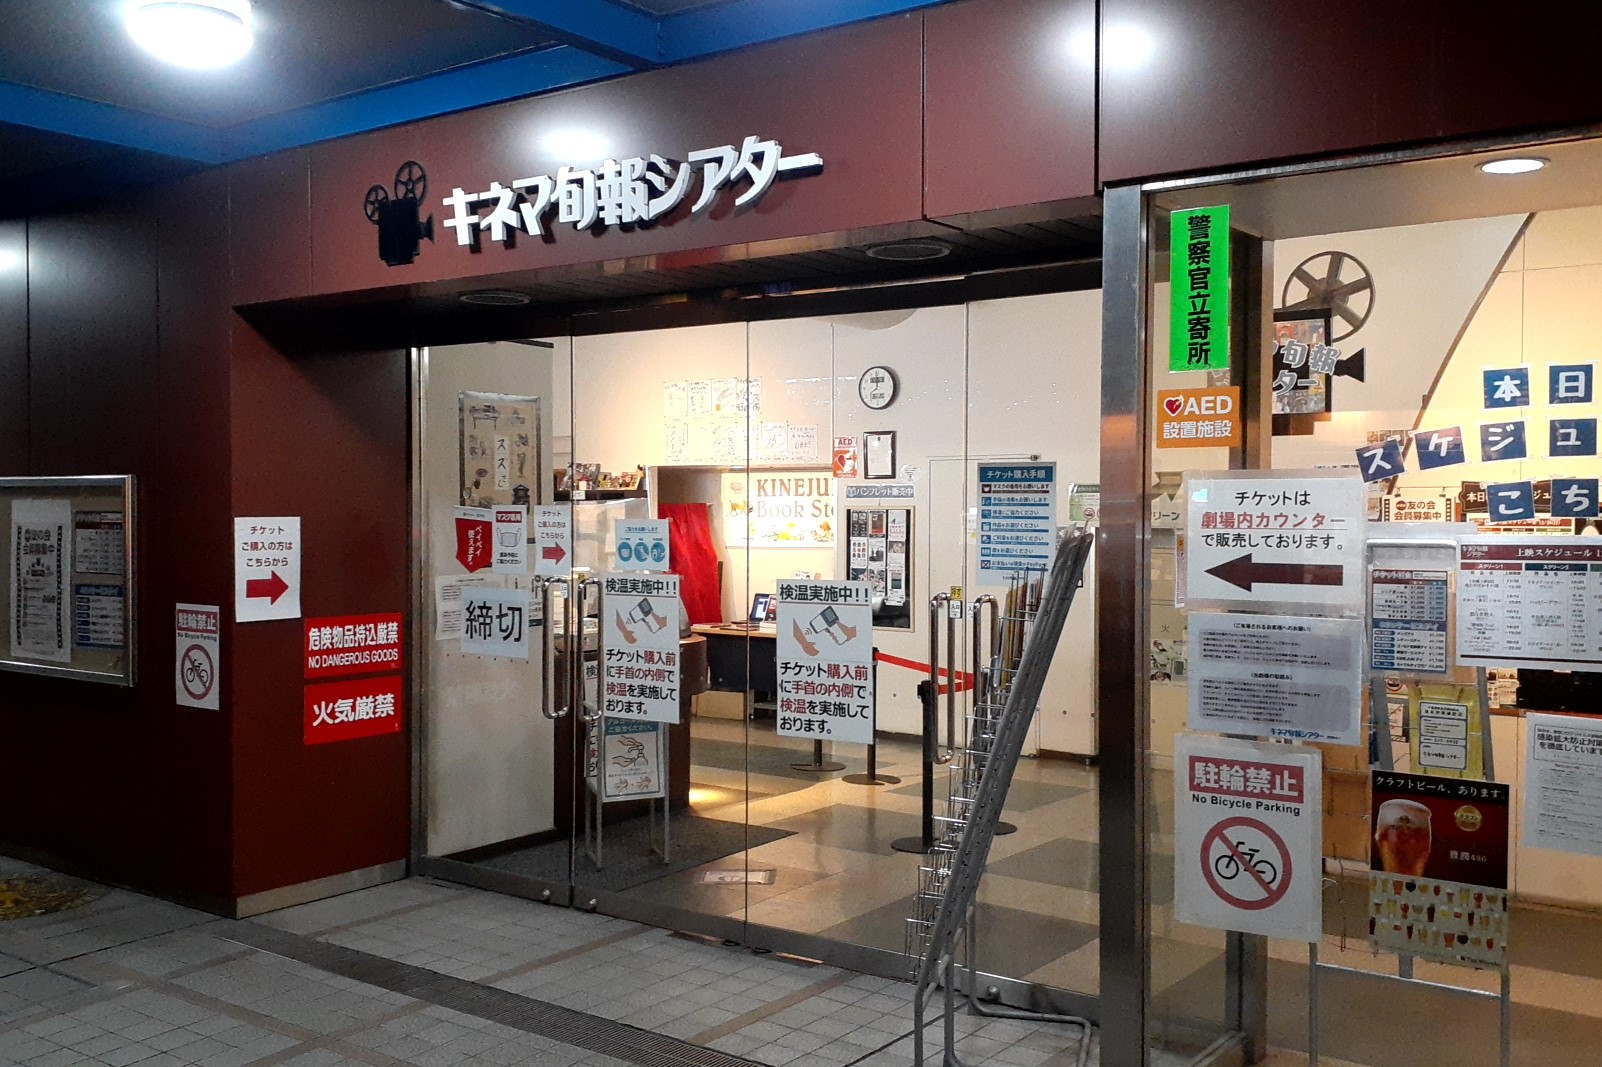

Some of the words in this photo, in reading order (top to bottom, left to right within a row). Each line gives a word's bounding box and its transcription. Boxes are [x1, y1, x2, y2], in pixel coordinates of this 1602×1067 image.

[443, 136, 824, 246] キネマ旬報シアター
[1187, 214, 1211, 366] 警察官立寄所
[1273, 339, 1340, 376] 旬報
[1493, 371, 1586, 402] 本日
[1184, 396, 1233, 415] AED
[1163, 420, 1233, 440] 設置施設
[837, 438, 853, 446] AED
[986, 470, 1046, 479] チケット購入手順
[756, 477, 834, 497] KINEJU
[1234, 490, 1311, 506] チケットは
[1201, 511, 1345, 529] 劇場内カウンター
[251, 526, 285, 535] チケット
[541, 532, 565, 540] こちらから
[242, 541, 293, 551] ご購入の方は
[1201, 532, 1343, 550] で販売しております。
[246, 557, 289, 567] こちらから
[605, 577, 677, 595] 検温実施中!!
[779, 584, 869, 603] 検温実施中!!
[465, 600, 523, 643] 締切
[308, 621, 399, 651] 危険物品持込厳禁
[308, 655, 321, 669] NO
[321, 650, 371, 668] DANGEROUS
[370, 648, 399, 662] GOODS
[605, 648, 677, 667] チケット購入前
[606, 665, 675, 683] に手首の内側で
[780, 661, 868, 681] チケット購入前
[605, 681, 677, 701] 検温を実施して
[780, 680, 867, 699] に手首の内側で
[312, 693, 395, 727] 火気厳禁
[605, 699, 648, 715] おります。
[780, 697, 869, 719] 検温を実施して
[780, 716, 832, 735] おります。
[1194, 762, 1299, 797] 駐輪禁止
[1192, 793, 1207, 804] No
[1210, 797, 1252, 810] Bicycle
[1256, 802, 1301, 817] Parking
